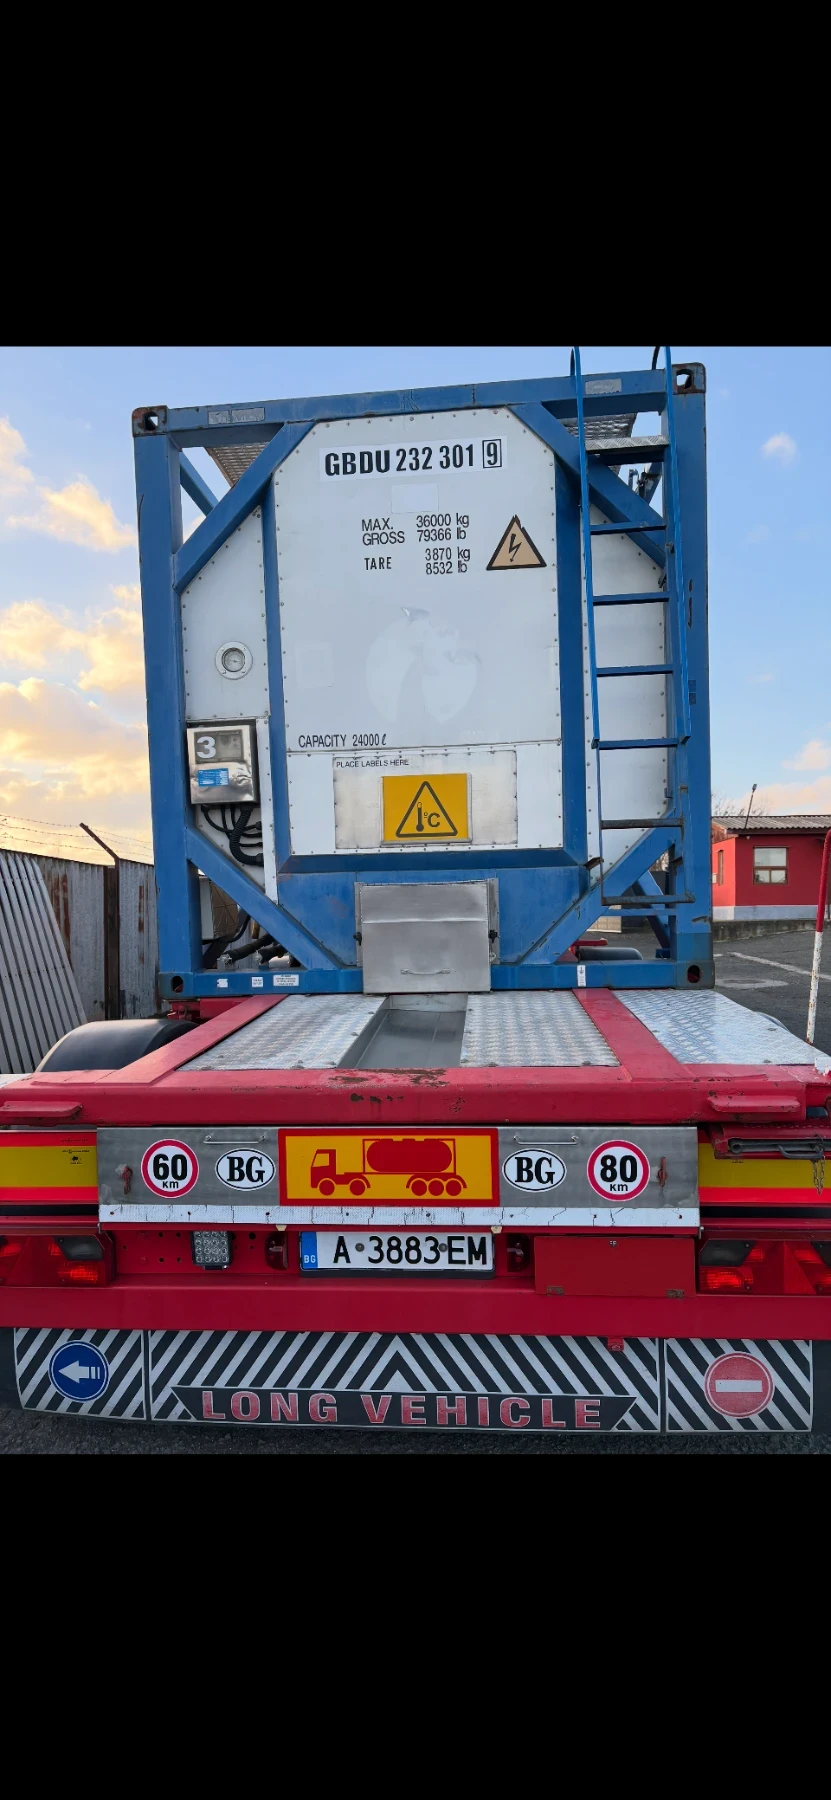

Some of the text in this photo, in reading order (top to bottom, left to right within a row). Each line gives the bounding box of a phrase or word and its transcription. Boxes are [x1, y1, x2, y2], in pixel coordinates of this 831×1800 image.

[325, 442, 498, 476] GBDU 232 301 9
[361, 513, 470, 531] MAX. 36000 kg
[362, 527, 467, 546] GROSS 79366 lb
[364, 546, 471, 570] TARE 3870 kg
[425, 560, 468, 575] 8532 lb
[196, 736, 217, 758] 3
[298, 734, 347, 748] CAPACITY
[352, 733, 380, 747] 24000
[336, 759, 410, 769] PLACE LABELS HERE
[153, 1154, 188, 1181] 60
[227, 1156, 265, 1183] BG
[514, 1157, 555, 1184] BG
[600, 1155, 637, 1183] 80
[304, 1255, 317, 1263] BG
[333, 1236, 487, 1264] A 3883 EM
[202, 1390, 601, 1428] LONG VEHICLE
